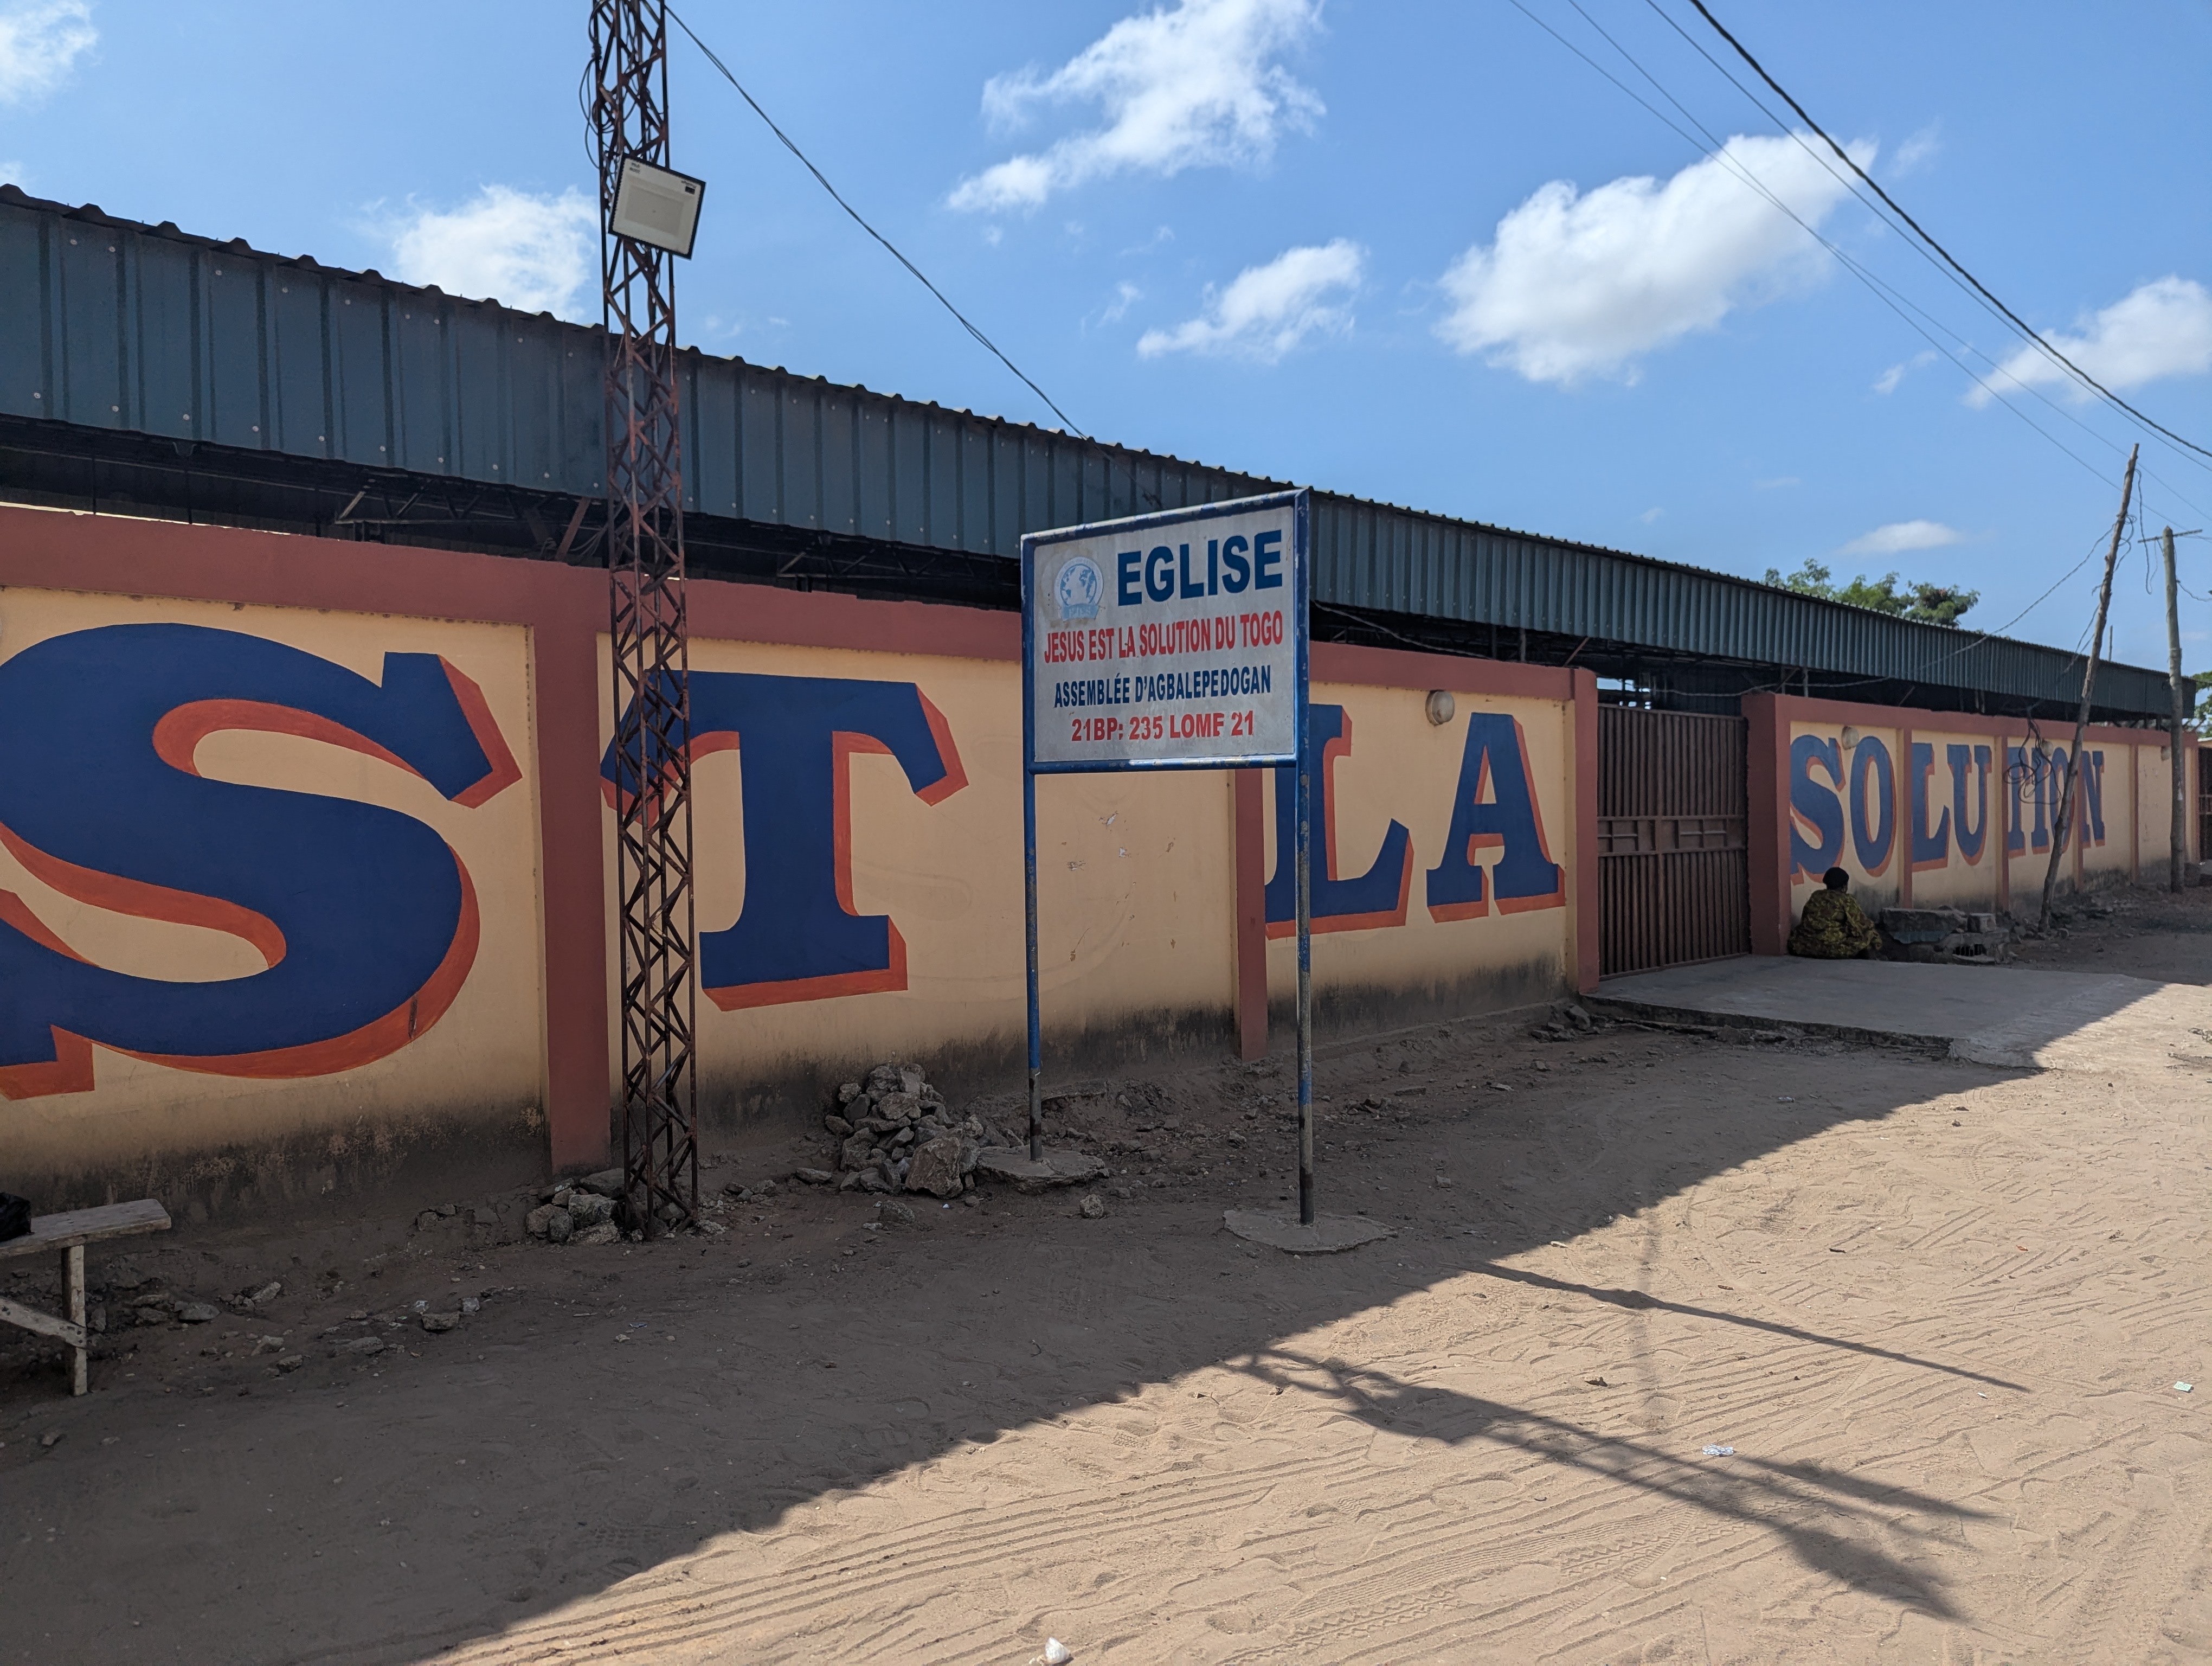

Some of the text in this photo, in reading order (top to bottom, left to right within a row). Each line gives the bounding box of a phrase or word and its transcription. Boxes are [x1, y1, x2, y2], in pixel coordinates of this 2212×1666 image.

[1117, 529, 1283, 607] EGLISE
[1044, 610, 1283, 664] JESUS EST LA SOLUTION DU TOGO
[1053, 672, 1130, 708] ASSEMBLÉE
[1071, 717, 1124, 742] 21BP:
[1128, 715, 1163, 740] 235
[1231, 710, 1255, 737] 21
